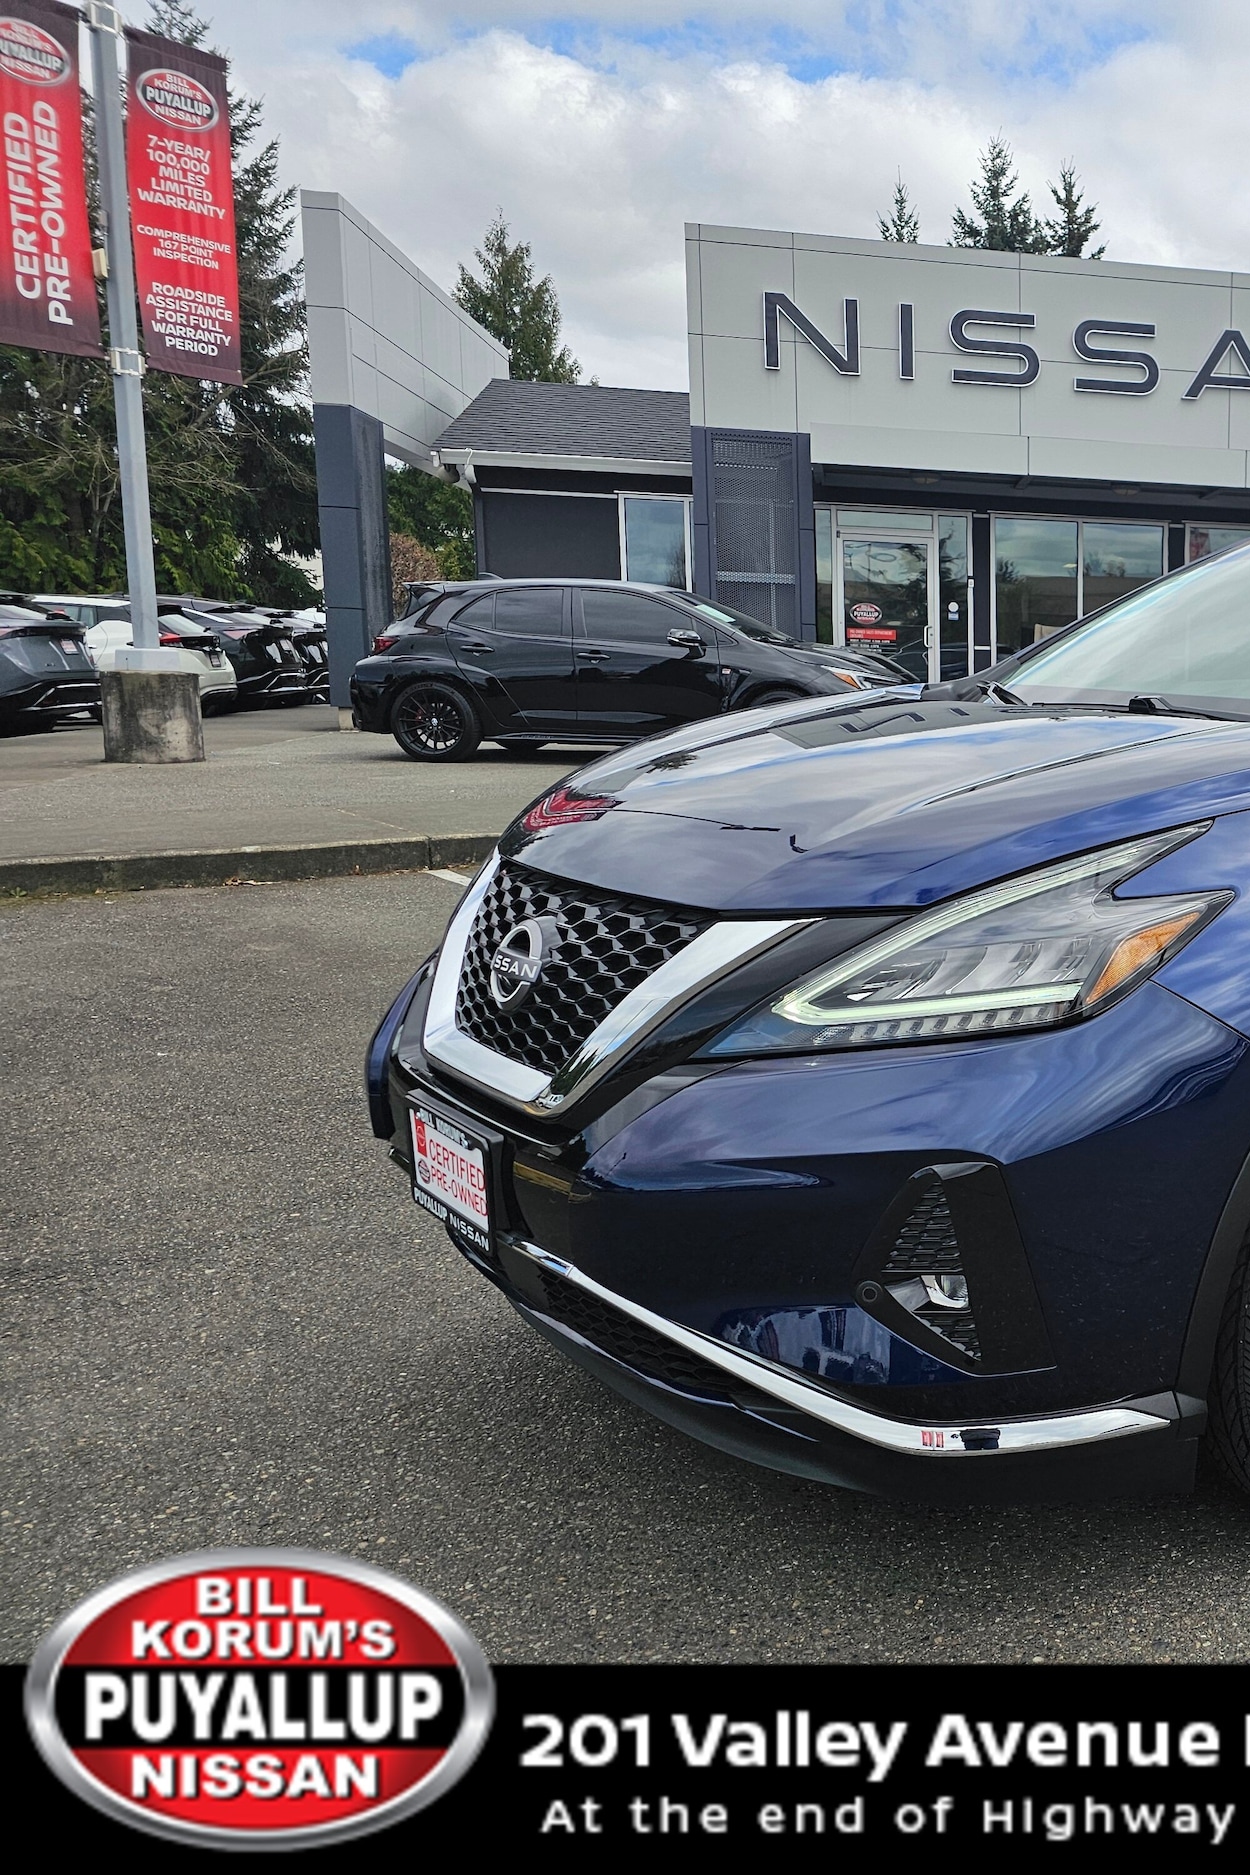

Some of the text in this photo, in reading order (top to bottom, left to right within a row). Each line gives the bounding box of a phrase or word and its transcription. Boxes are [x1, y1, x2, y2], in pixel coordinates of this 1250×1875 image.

[0, 40, 64, 72] UYALLUP
[154, 79, 202, 100] KORUM'S
[166, 73, 189, 88] BILL
[146, 86, 211, 117] PUYALLUP
[155, 104, 201, 125] NISSAN
[147, 134, 211, 162] 7-YEAR/
[146, 149, 210, 175] 100,000
[159, 165, 206, 187] MILES
[151, 177, 212, 202] LIMITED
[4, 112, 41, 299] CERTIFIED
[33, 101, 74, 325] PRE-OWNED
[137, 188, 226, 219] WARRANTY
[137, 224, 231, 254] COMPREHENSIVE
[158, 239, 214, 258] 167 POINT
[153, 247, 219, 270] INSPECTION
[146, 294, 233, 322] ASSISTANCE
[152, 282, 226, 308] ROADSIDE
[152, 320, 232, 347] WARRANTY
[156, 309, 223, 332] FOR FULL
[165, 336, 219, 356] PERIOD
[494, 955, 538, 979] SSAN
[429, 1139, 487, 1192] CERTIFIED
[431, 1165, 488, 1217] PRE-OWNED
[414, 1187, 490, 1251] PUYALLUP NISSAN
